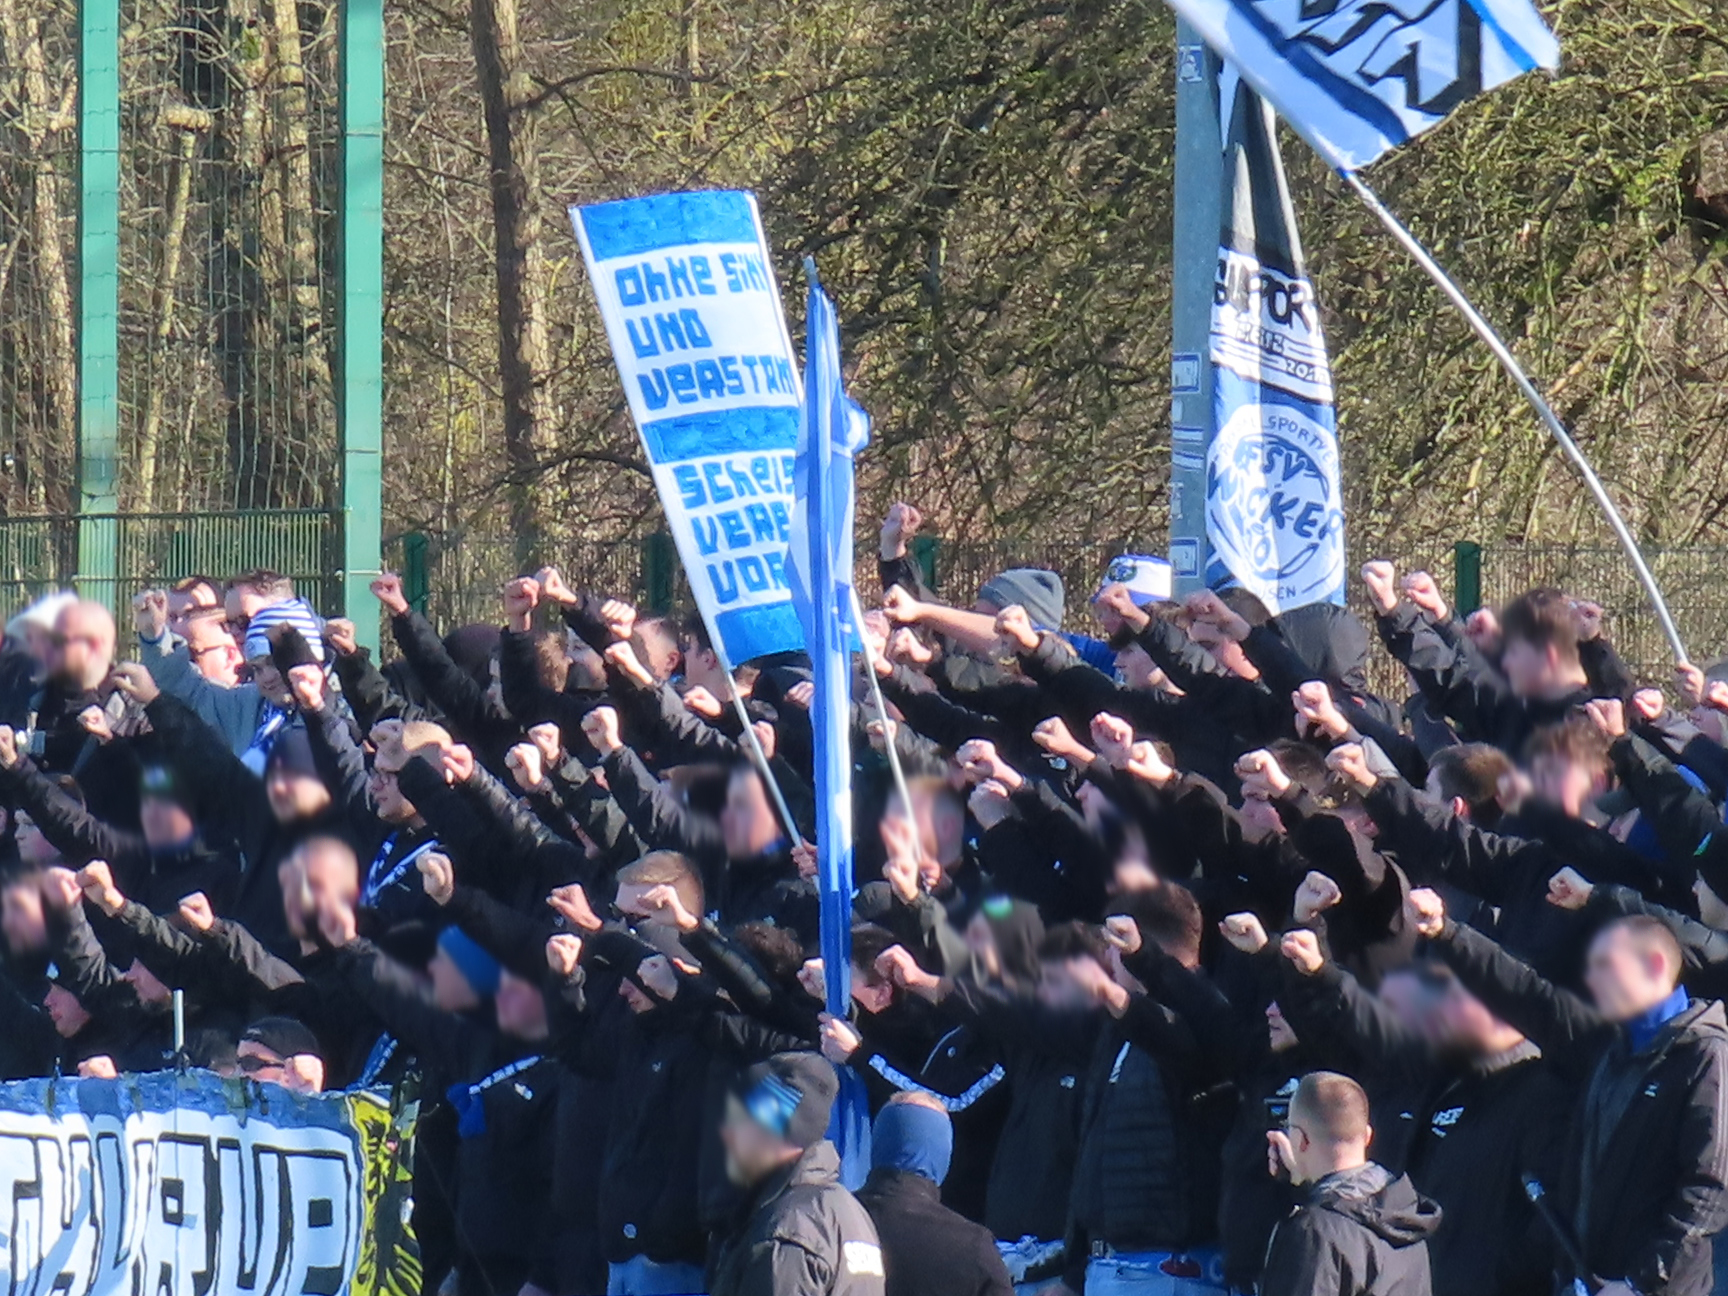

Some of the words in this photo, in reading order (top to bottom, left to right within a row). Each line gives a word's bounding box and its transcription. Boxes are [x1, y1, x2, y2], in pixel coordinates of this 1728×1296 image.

[625, 308, 713, 359] UND
[637, 354, 794, 412] VeRSTAN
[672, 456, 795, 510] SCheIS
[691, 500, 790, 557] VeRe
[706, 551, 790, 604] VOR
